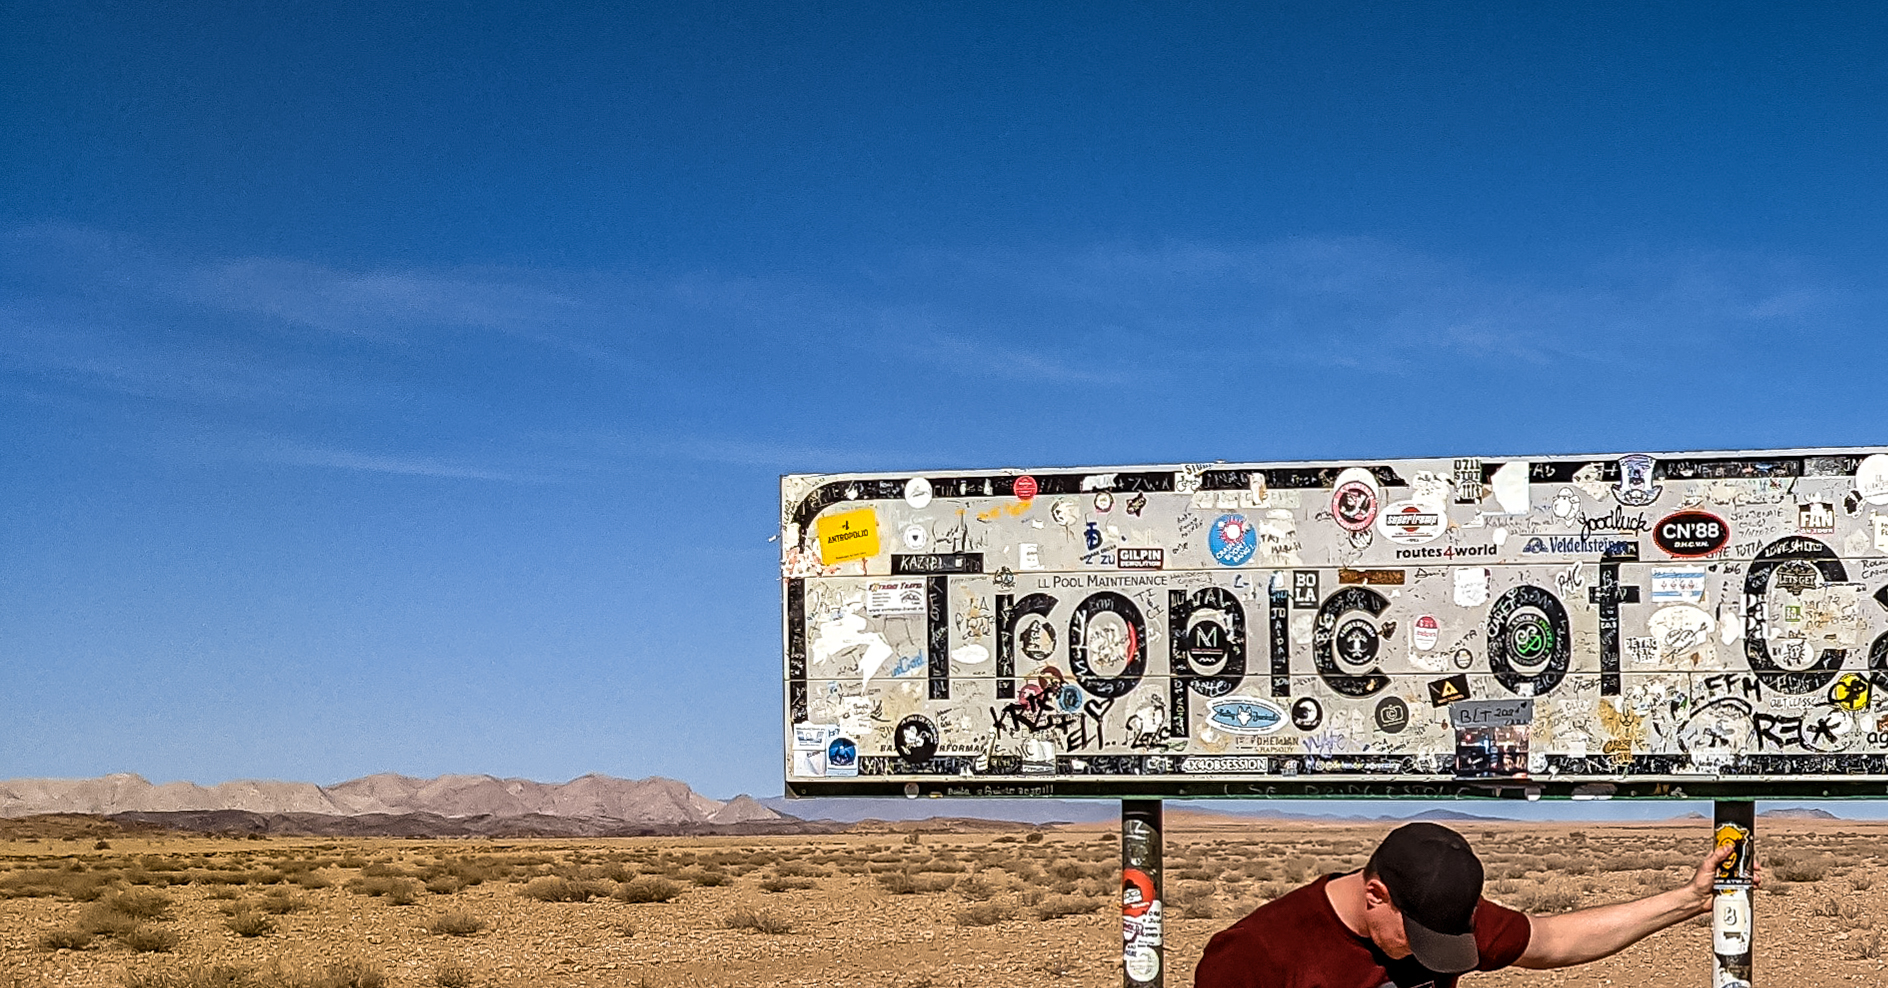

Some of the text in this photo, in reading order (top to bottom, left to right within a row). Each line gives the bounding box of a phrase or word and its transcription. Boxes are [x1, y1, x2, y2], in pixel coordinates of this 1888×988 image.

[1662, 523, 1720, 539] CN'88
[1120, 550, 1161, 560] GILPIN
[1396, 544, 1497, 560] routes4world
[1296, 573, 1316, 587] BO
[1295, 588, 1318, 602] LA
[891, 553, 1391, 738] Tropic
[1486, 540, 1640, 698] of
